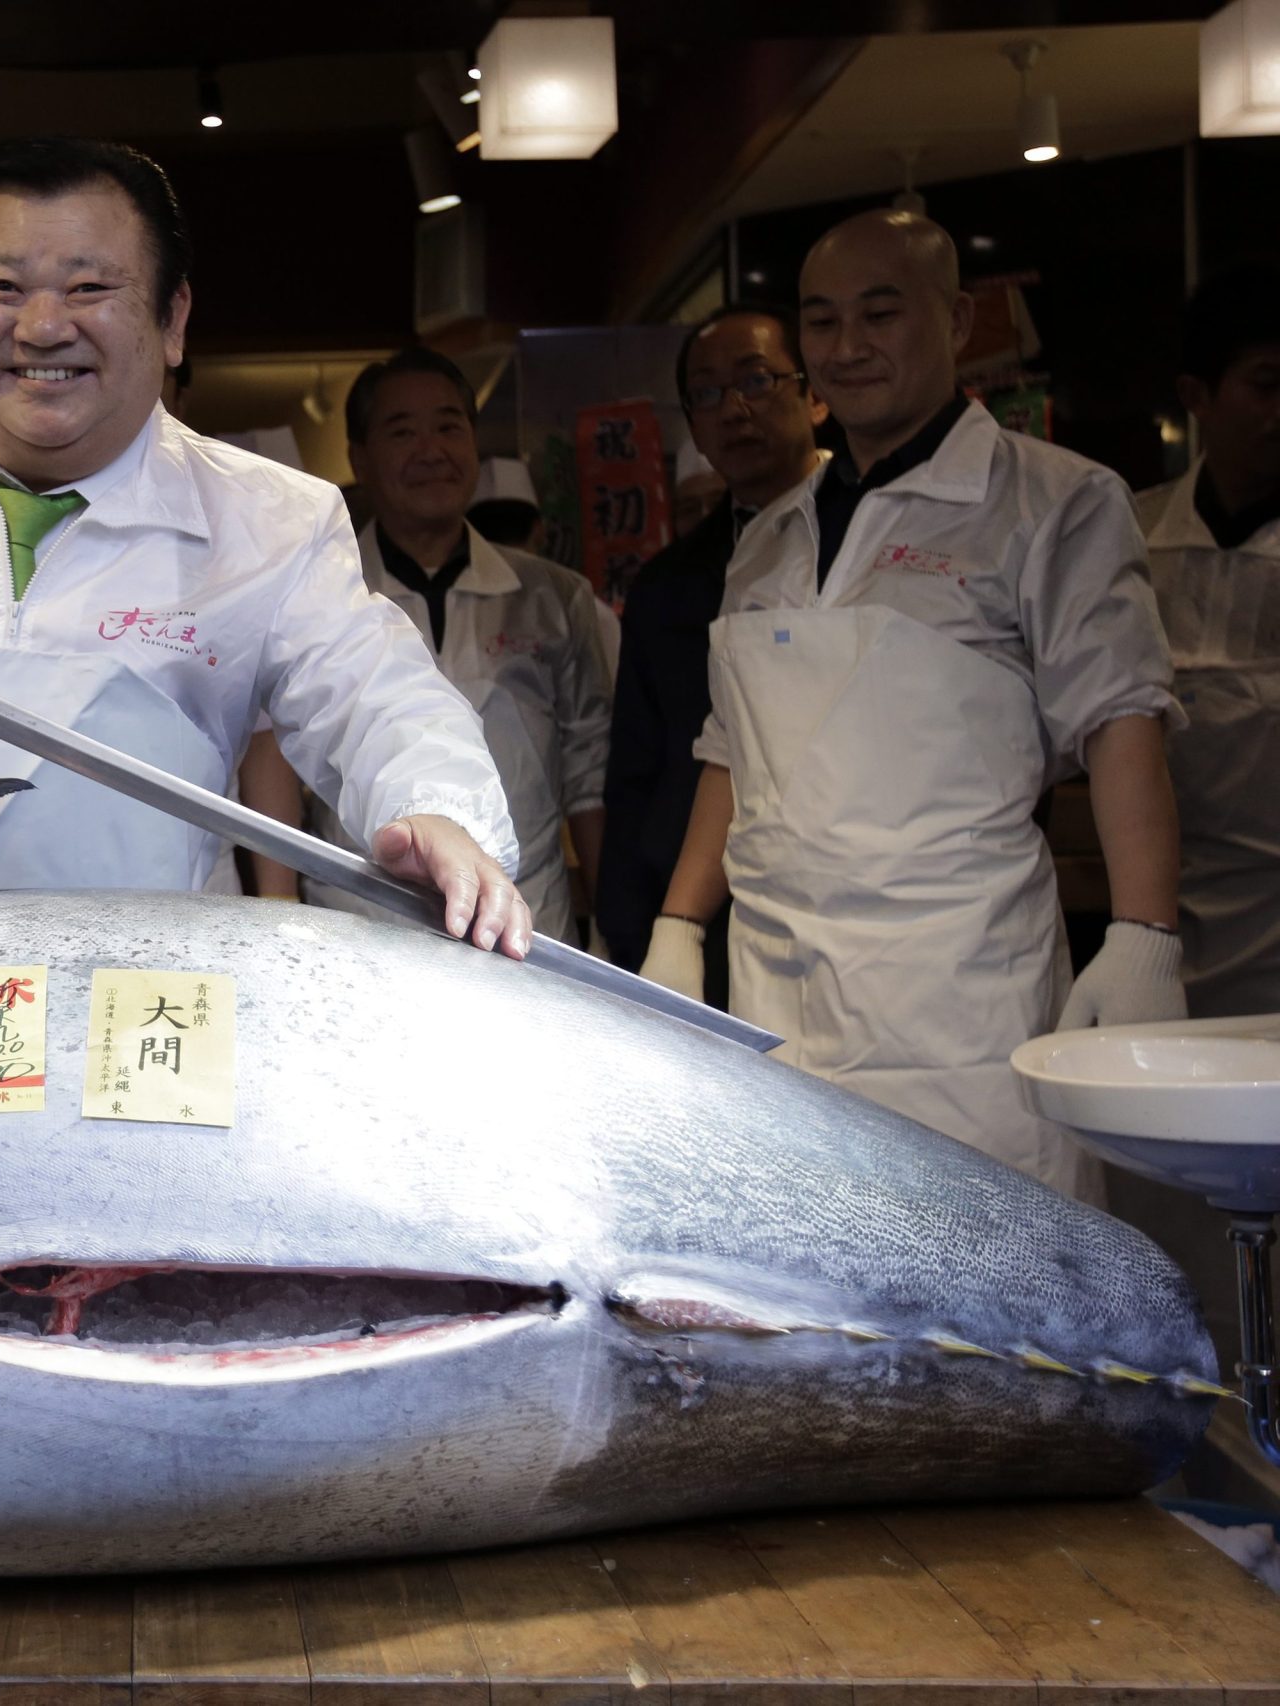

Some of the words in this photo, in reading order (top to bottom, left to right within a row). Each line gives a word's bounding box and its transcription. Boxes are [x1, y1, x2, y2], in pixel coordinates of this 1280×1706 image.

[138, 995, 190, 1075] 大間
[192, 982, 212, 1027] 青森県
